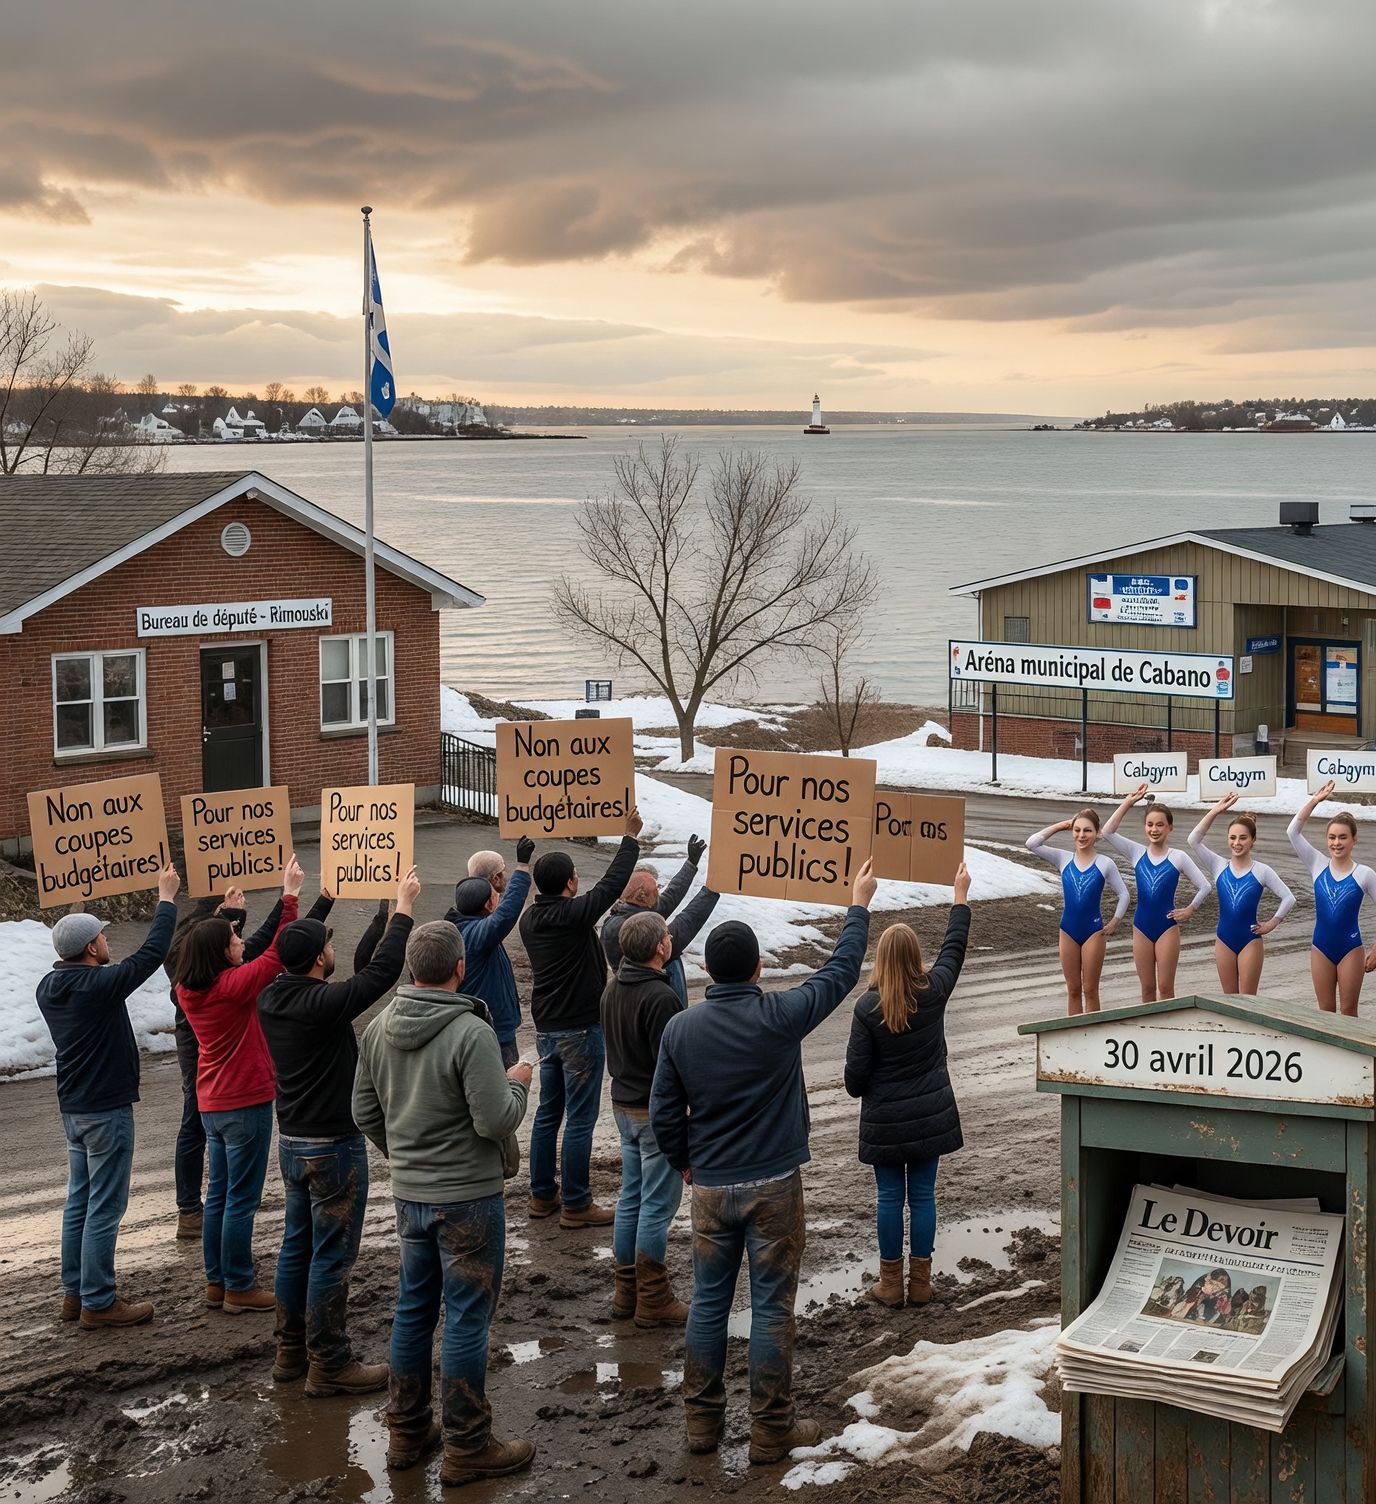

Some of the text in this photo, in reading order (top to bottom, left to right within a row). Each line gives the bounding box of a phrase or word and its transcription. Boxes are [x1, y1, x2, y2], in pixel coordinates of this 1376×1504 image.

[141, 612, 188, 630] Bureau
[193, 610, 208, 627] de
[213, 607, 258, 631] député
[270, 603, 329, 623] Rimouski
[964, 649, 1015, 675] Aréna
[1020, 654, 1106, 686] municipal
[1111, 657, 1134, 681] de
[1139, 660, 1211, 688] Cabano
[515, 726, 611, 759] Non aux
[524, 767, 601, 796] coupes
[729, 755, 850, 804] Pour nos
[1123, 761, 1178, 784] Cabgym
[1209, 765, 1266, 788] Cabgym
[1317, 756, 1376, 784] Cabgym
[46, 792, 143, 826] Non aux
[192, 797, 274, 826] Pour nos
[329, 791, 398, 823] Pour nos
[55, 825, 133, 855] coupes
[198, 826, 276, 852] services
[332, 826, 396, 851] services
[734, 808, 850, 844] services
[1103, 1038, 1303, 1083] 30 avril 2026
[1138, 1199, 1178, 1233] Le
[1180, 1207, 1278, 1250] Devoir
